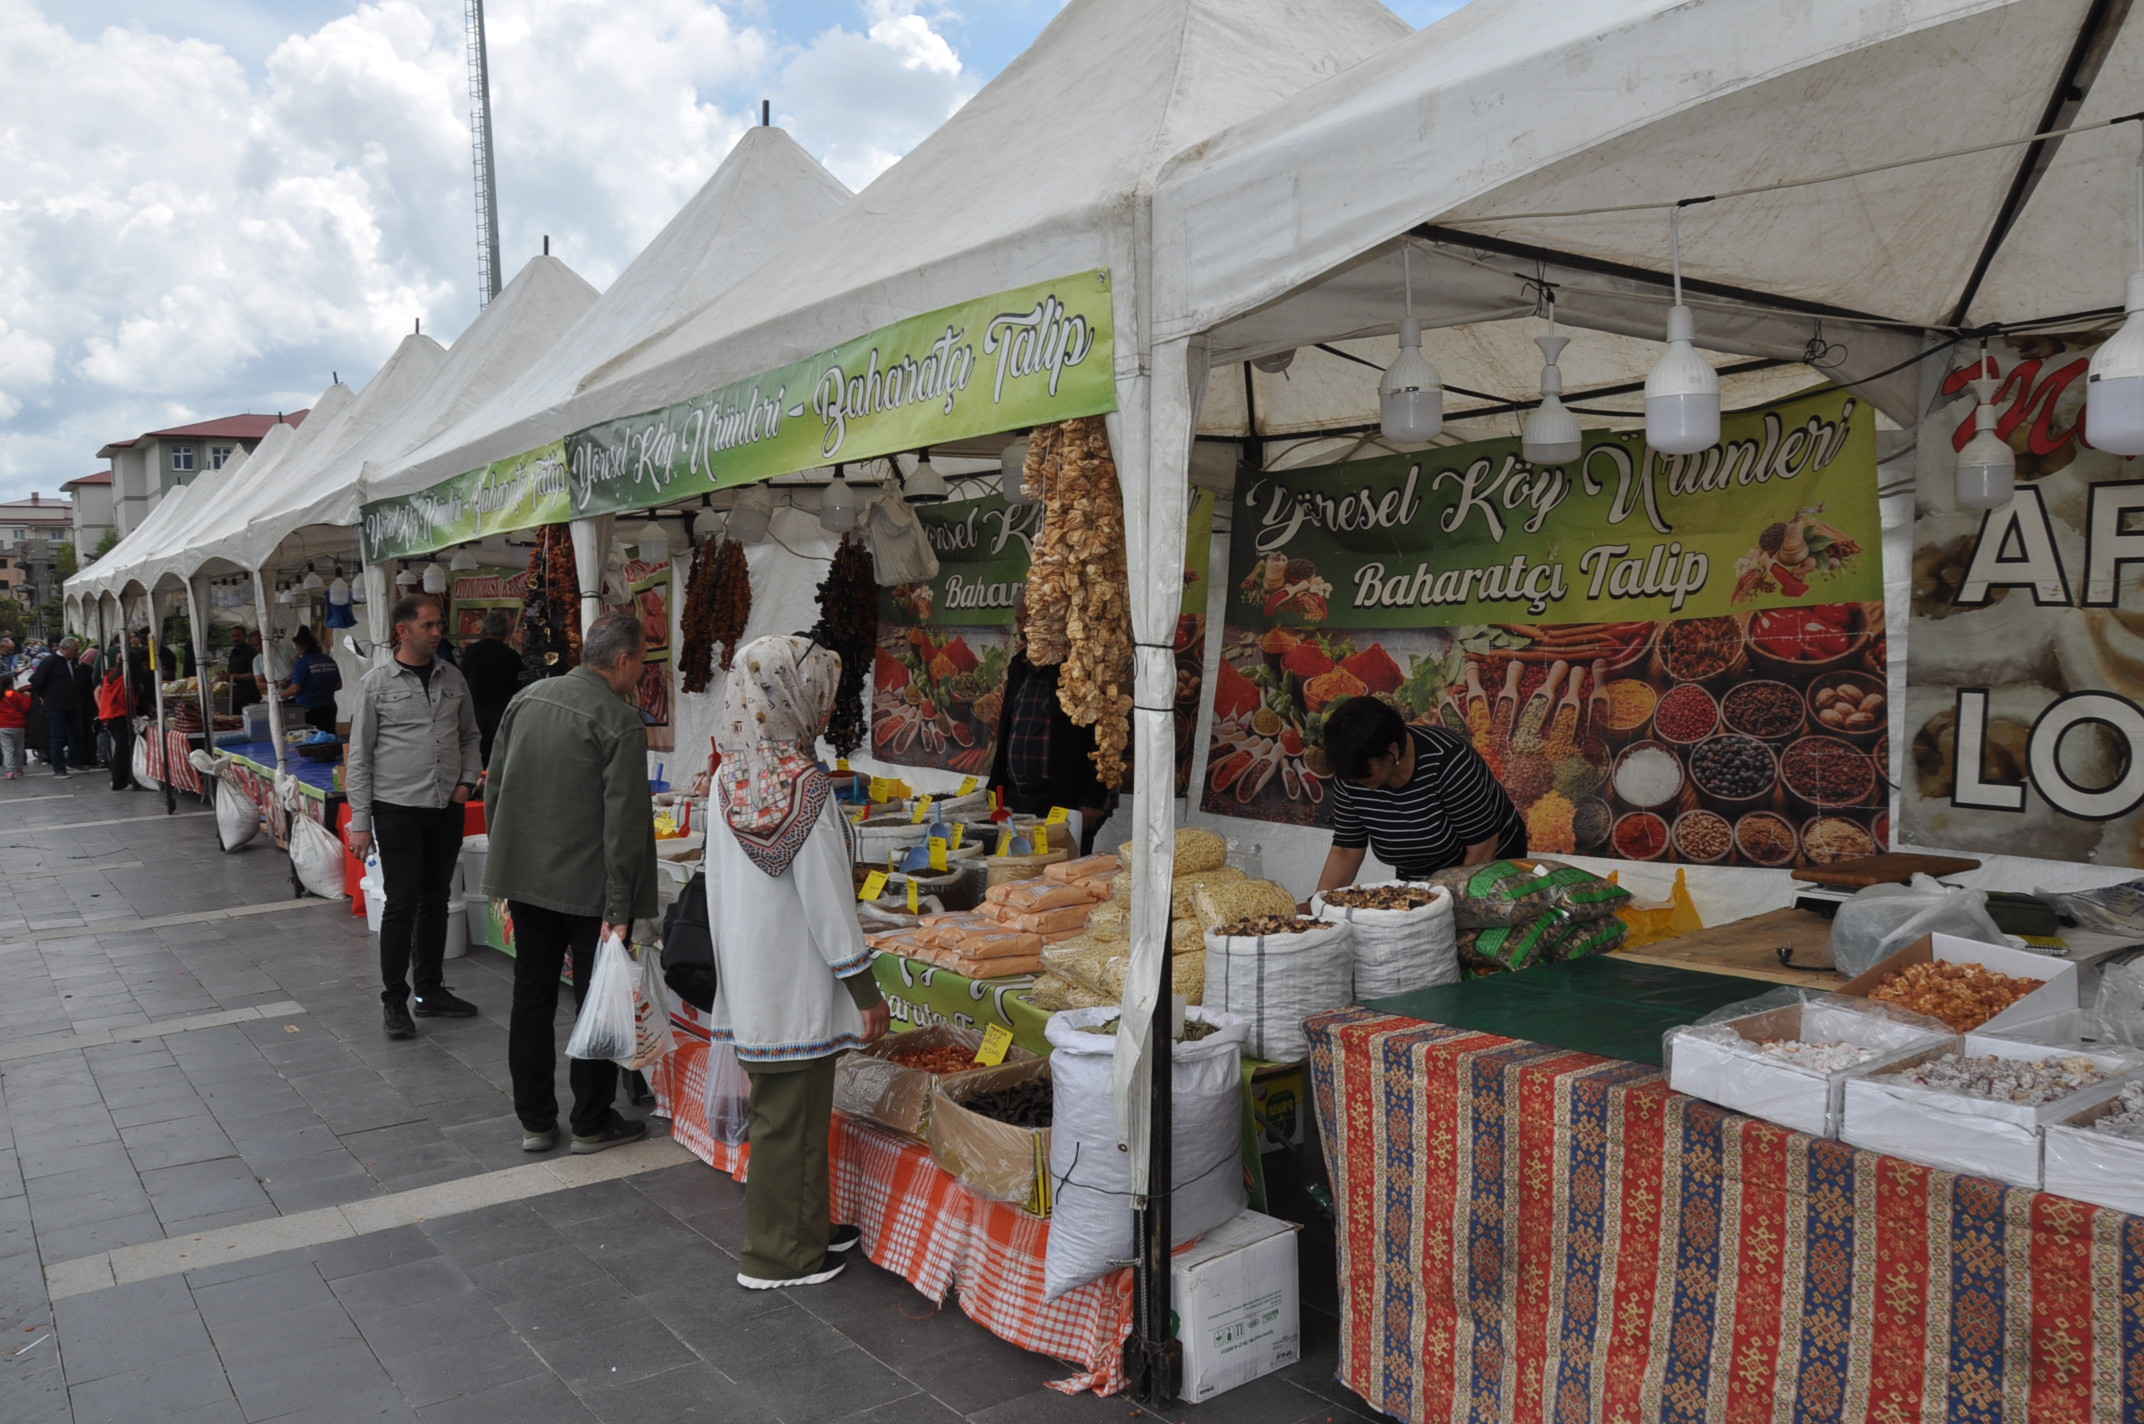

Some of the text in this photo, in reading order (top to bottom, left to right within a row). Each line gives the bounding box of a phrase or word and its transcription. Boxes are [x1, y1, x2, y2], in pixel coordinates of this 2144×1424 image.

[573, 427, 631, 511] Yöresel
[631, 422, 678, 494] Köy
[682, 385, 787, 483] Ürünleri
[813, 323, 976, 460] Baharatçı
[983, 294, 1096, 405] Talip
[1246, 397, 1857, 551] Yöresel Köy Ürünleri
[1352, 541, 1710, 615] Baharatçı Talip
[1951, 686, 2144, 822] LO
